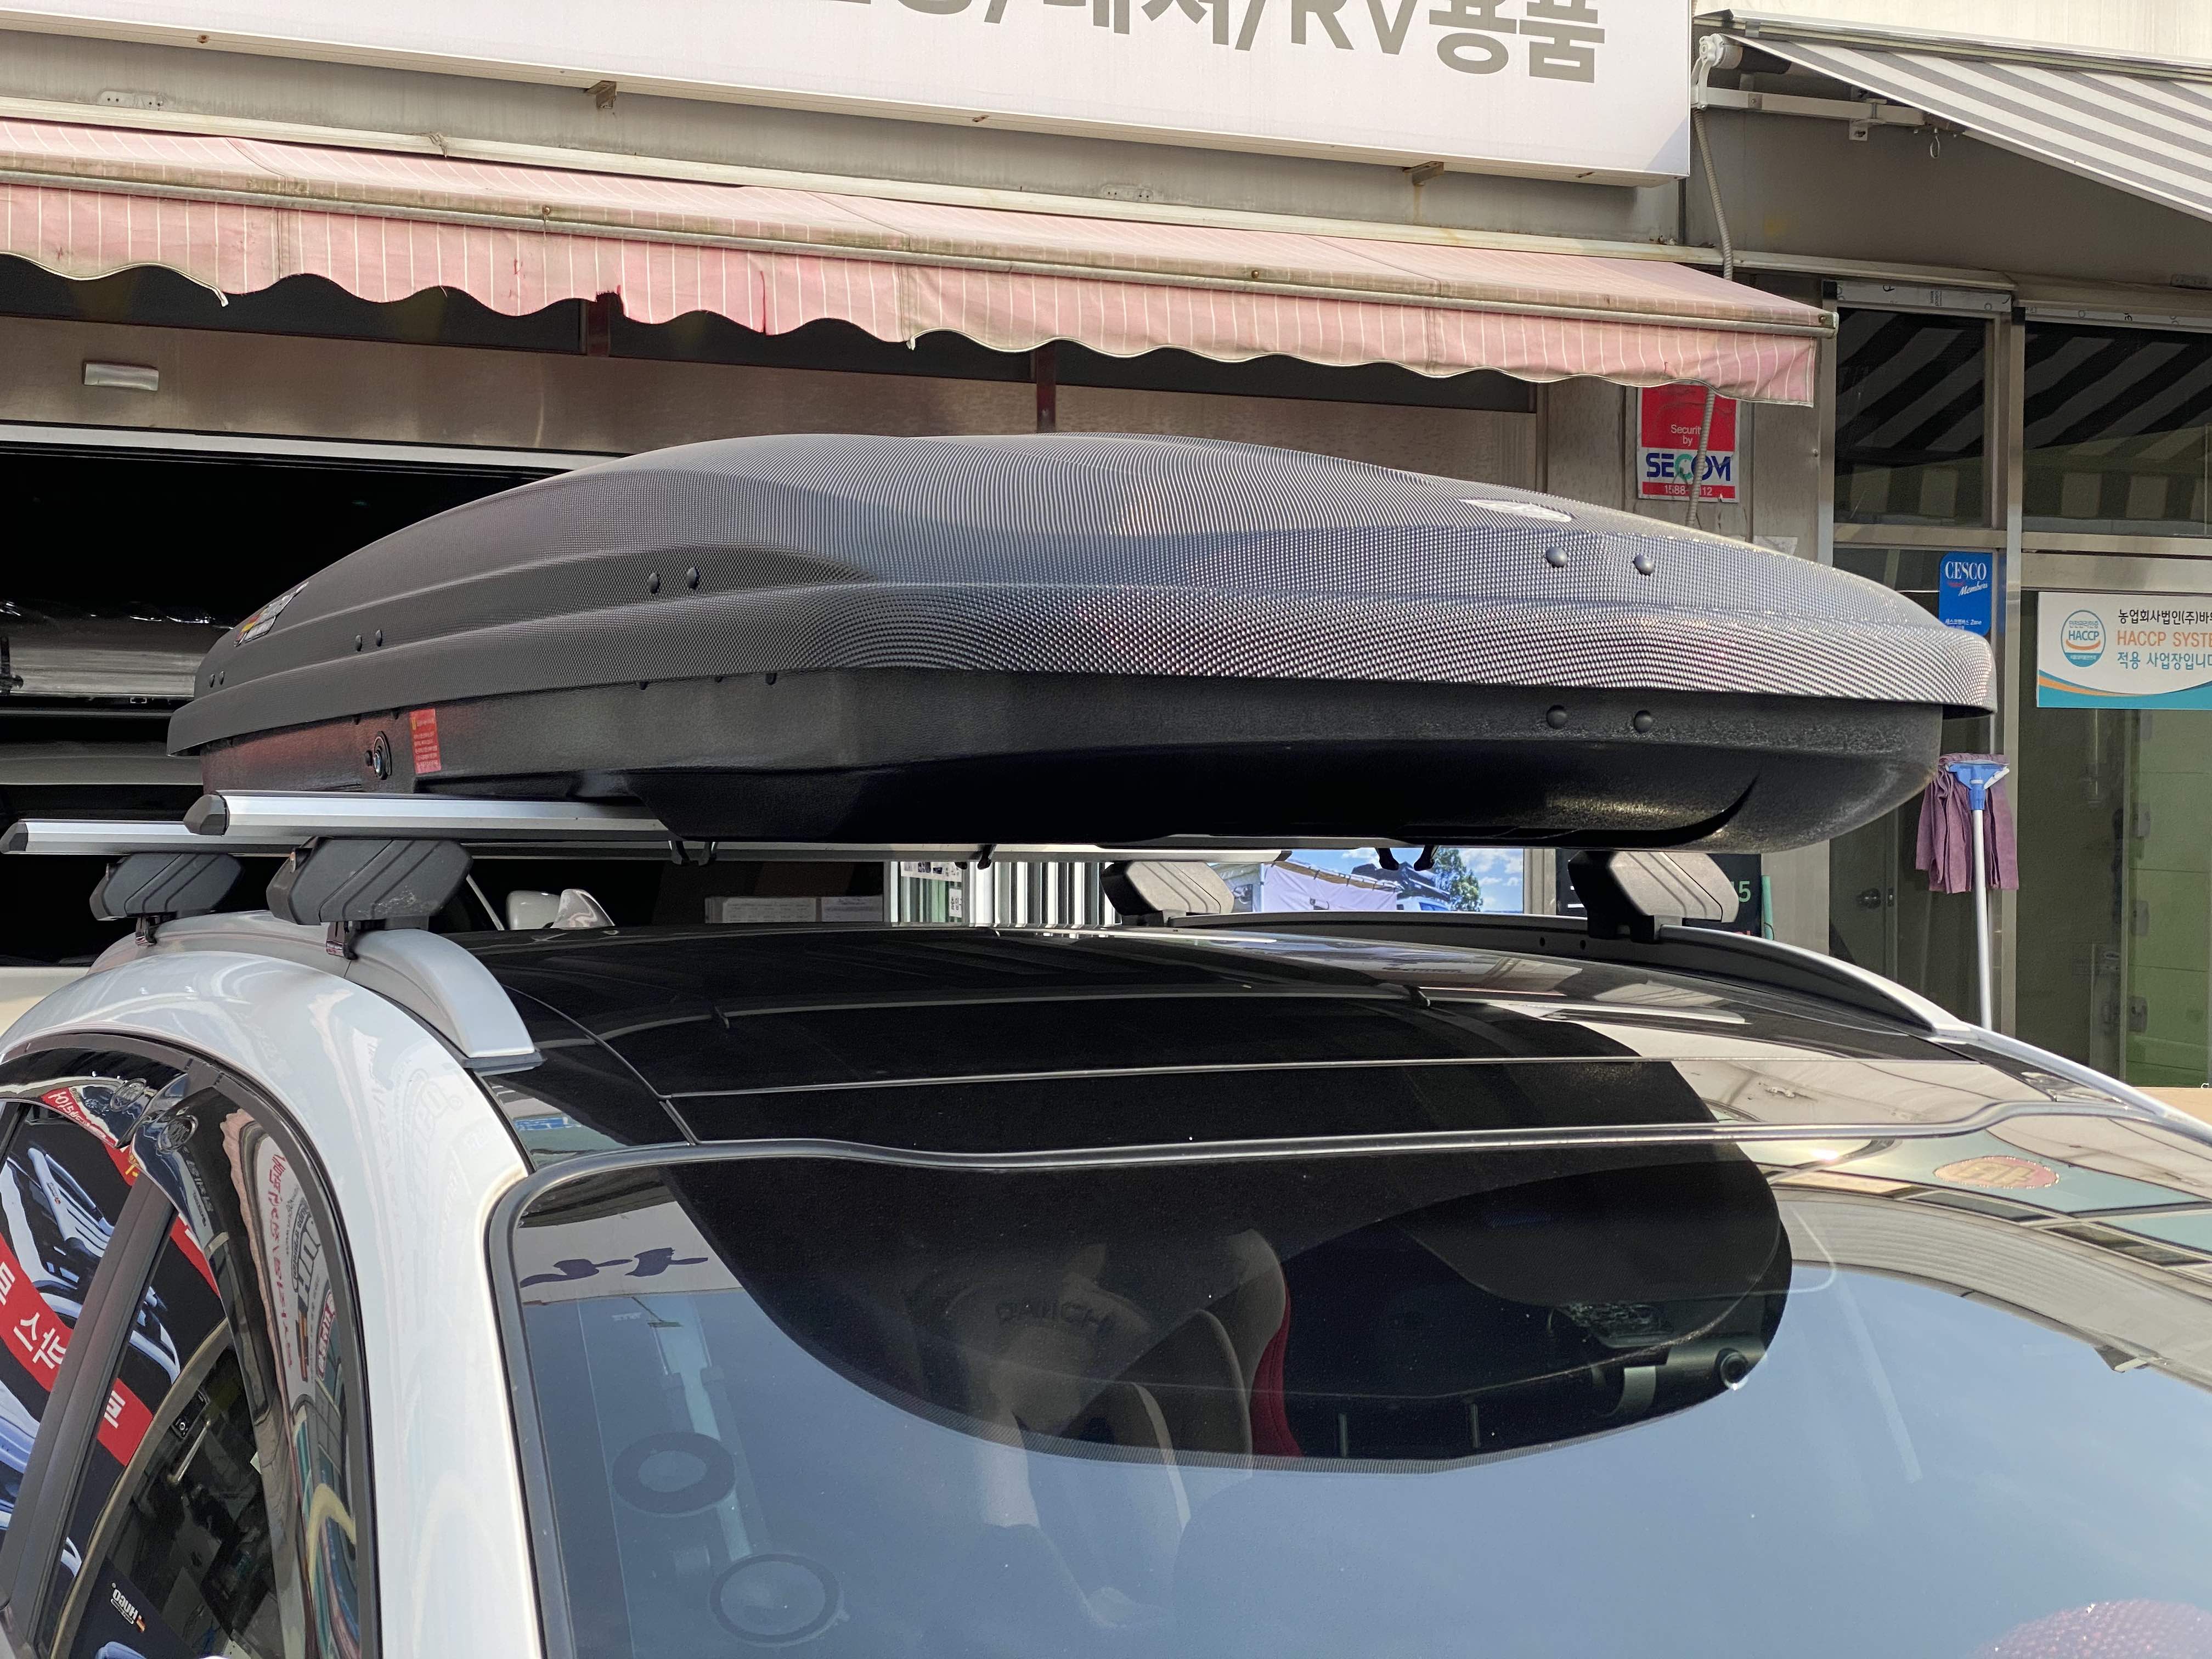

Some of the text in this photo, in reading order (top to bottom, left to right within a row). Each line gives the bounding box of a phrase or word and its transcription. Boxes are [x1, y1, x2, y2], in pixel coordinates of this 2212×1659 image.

[1671, 424, 1702, 435] Securit
[1683, 435, 1693, 447] by
[1646, 453, 1731, 481] SECOM
[1664, 484, 1712, 496] 1588-112
[1945, 561, 1987, 580] CESCO
[1958, 581, 1988, 596] Members
[2069, 630, 2100, 641] HACCP
[2117, 630, 2166, 647] HACCP
[2117, 651, 2141, 669] 적용
